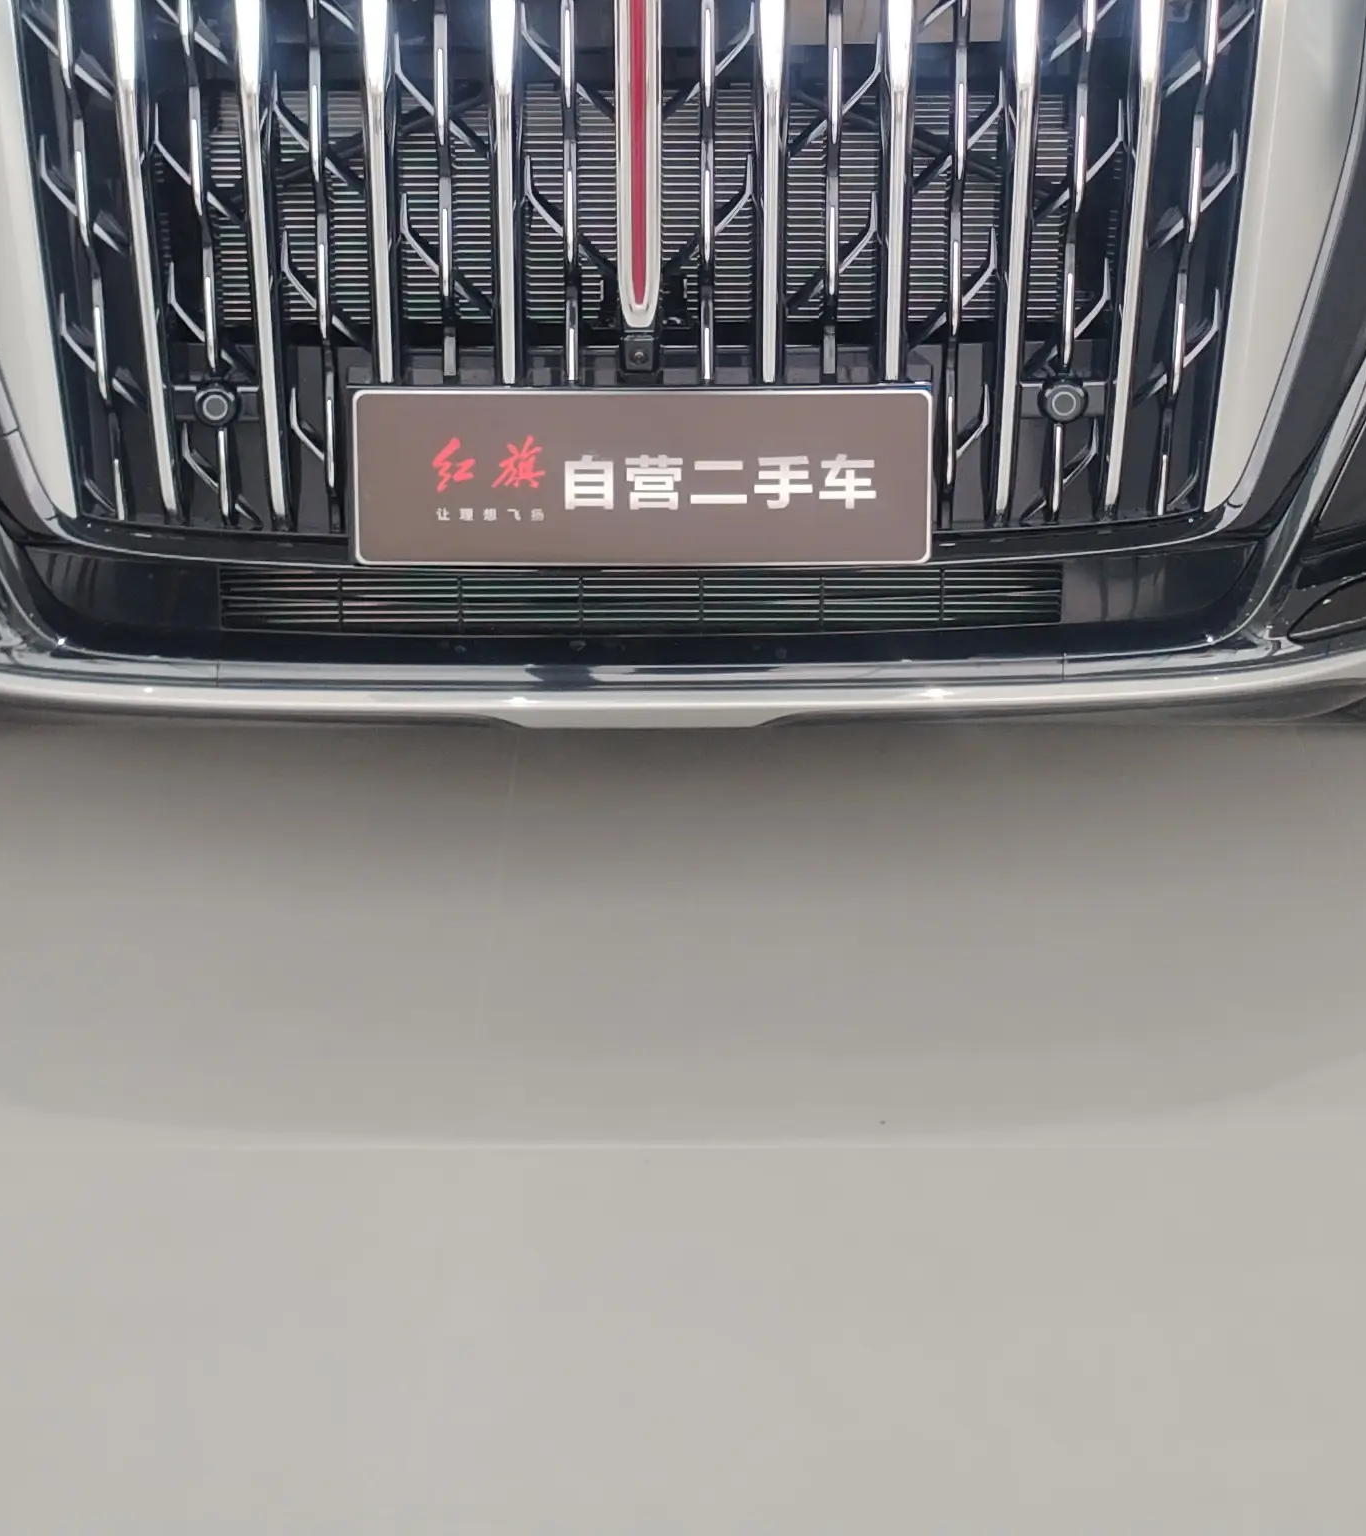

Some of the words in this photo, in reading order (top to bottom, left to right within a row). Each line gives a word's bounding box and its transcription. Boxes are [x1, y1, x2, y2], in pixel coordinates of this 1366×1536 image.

[432, 435, 546, 492] 红旗
[563, 453, 877, 511] 自营二手车
